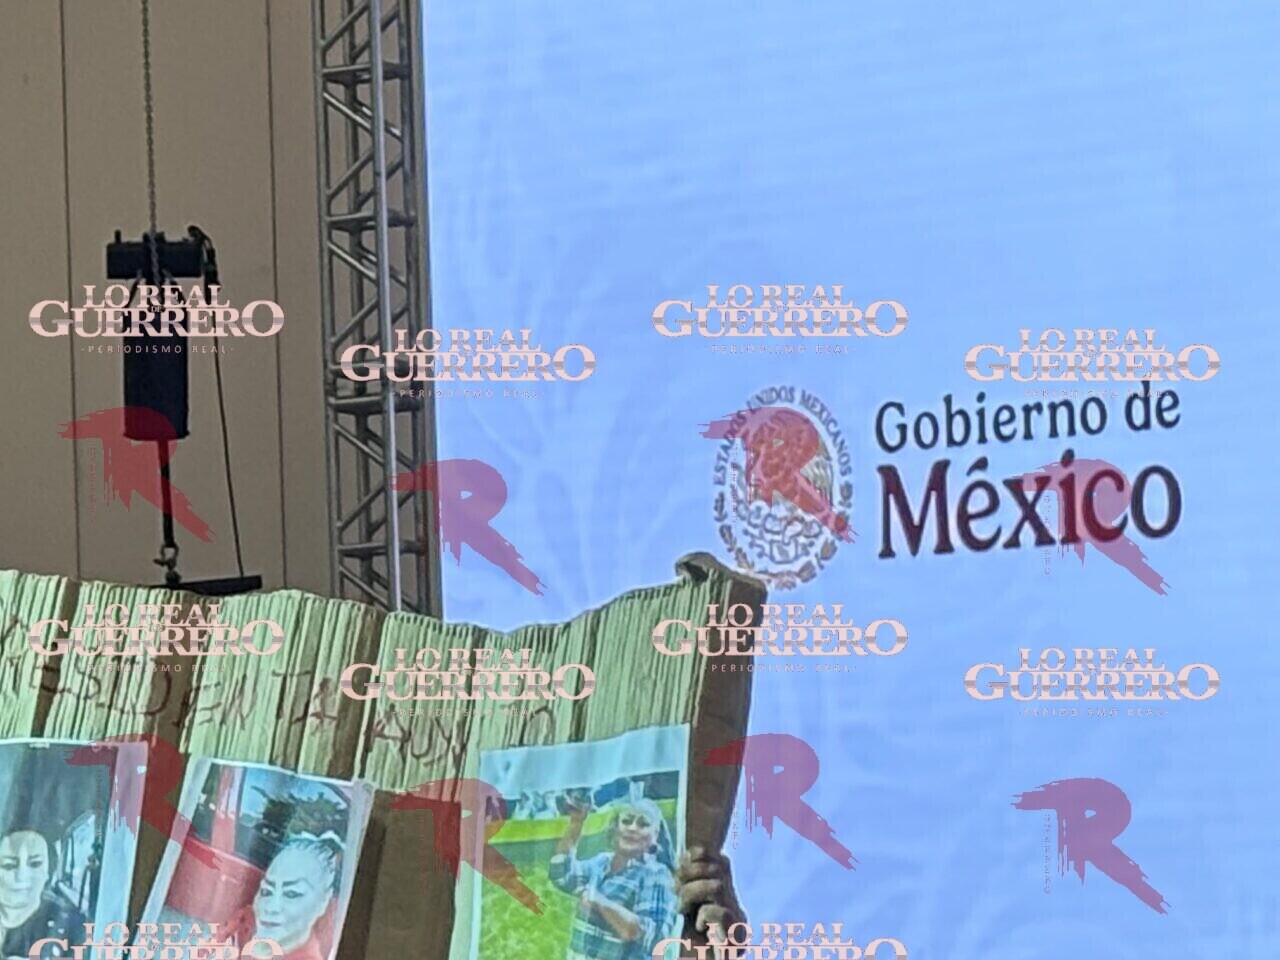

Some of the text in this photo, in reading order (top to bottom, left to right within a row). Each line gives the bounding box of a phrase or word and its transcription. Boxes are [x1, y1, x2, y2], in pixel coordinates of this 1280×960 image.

[800, 389, 853, 477] MEXICANOS
[875, 382, 1182, 454] Gobierno de
[877, 448, 1183, 560] México
